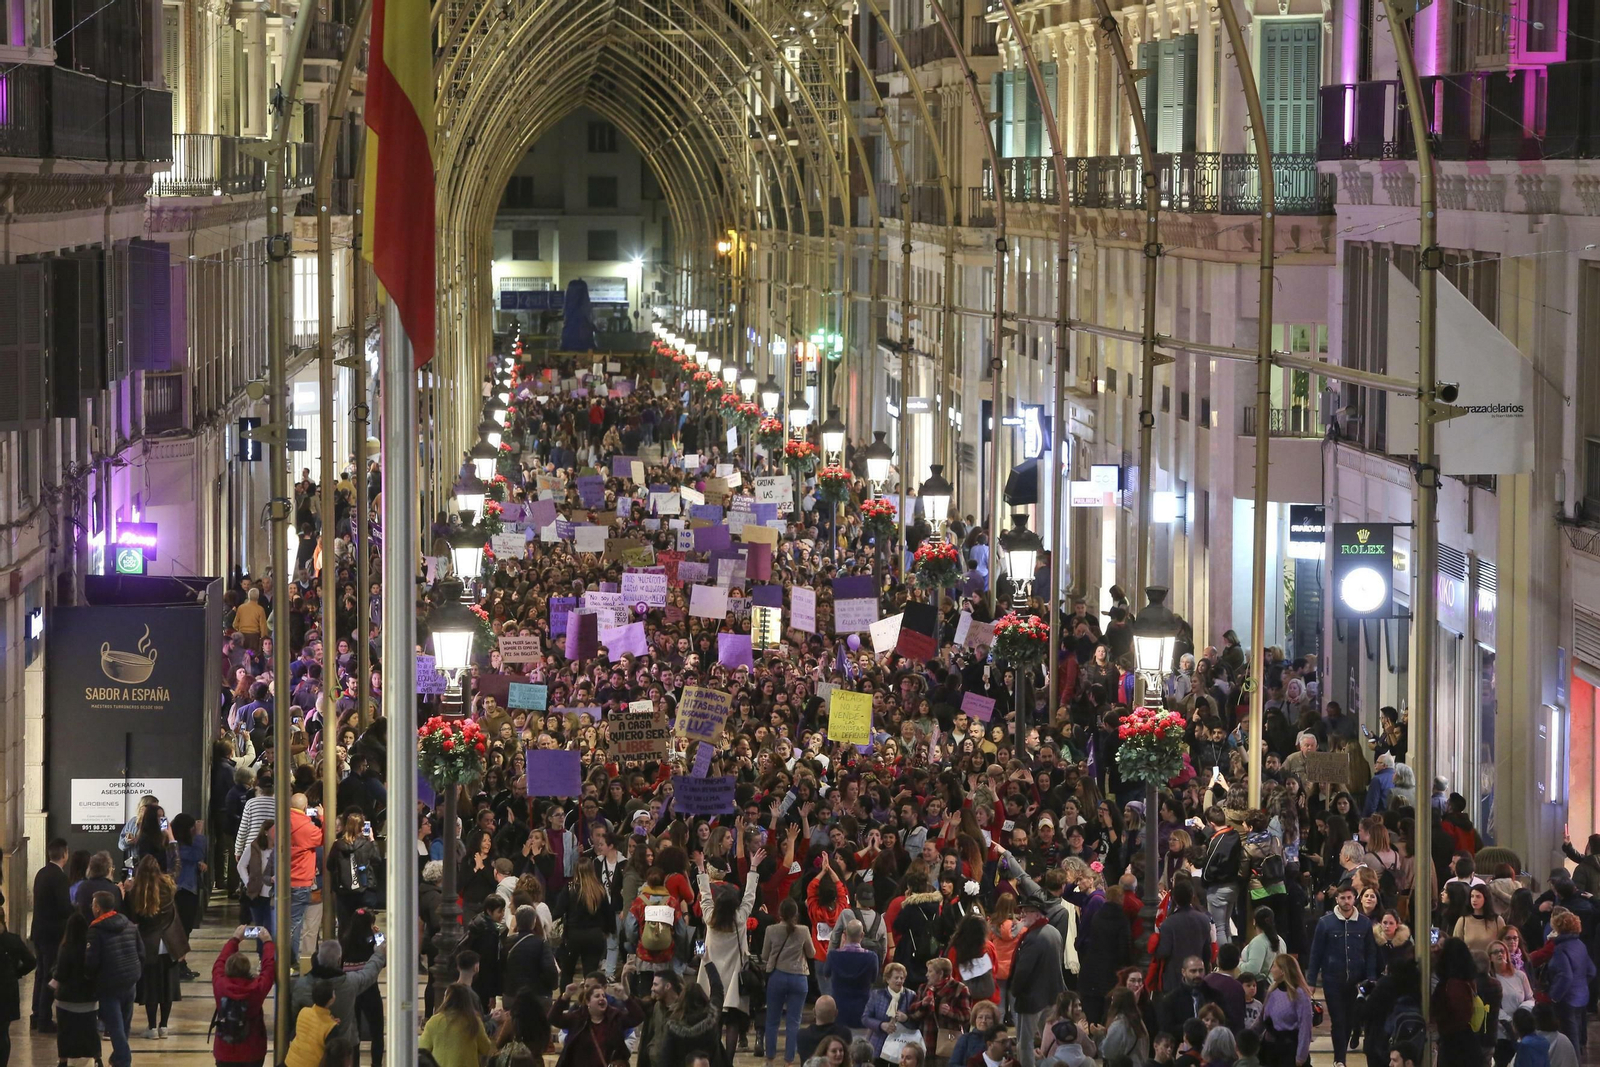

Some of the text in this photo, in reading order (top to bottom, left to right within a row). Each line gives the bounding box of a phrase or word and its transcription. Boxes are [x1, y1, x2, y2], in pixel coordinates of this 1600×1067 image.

[1455, 403, 1524, 413] razadelarios
[763, 491, 773, 499] LAS
[1341, 545, 1385, 554] ROLEX
[85, 686, 170, 701] SABOR A ESPAÑA
[683, 699, 707, 710] HIJAS
[715, 704, 728, 715] EVA
[609, 713, 623, 721] DE
[619, 720, 652, 730] A CASA
[686, 718, 715, 737] LUZ
[830, 723, 865, 731] FEMINISTAS
[610, 729, 665, 744] QUIERO SER
[618, 740, 654, 753] LIBRE
[622, 752, 663, 761] VALIENTE
